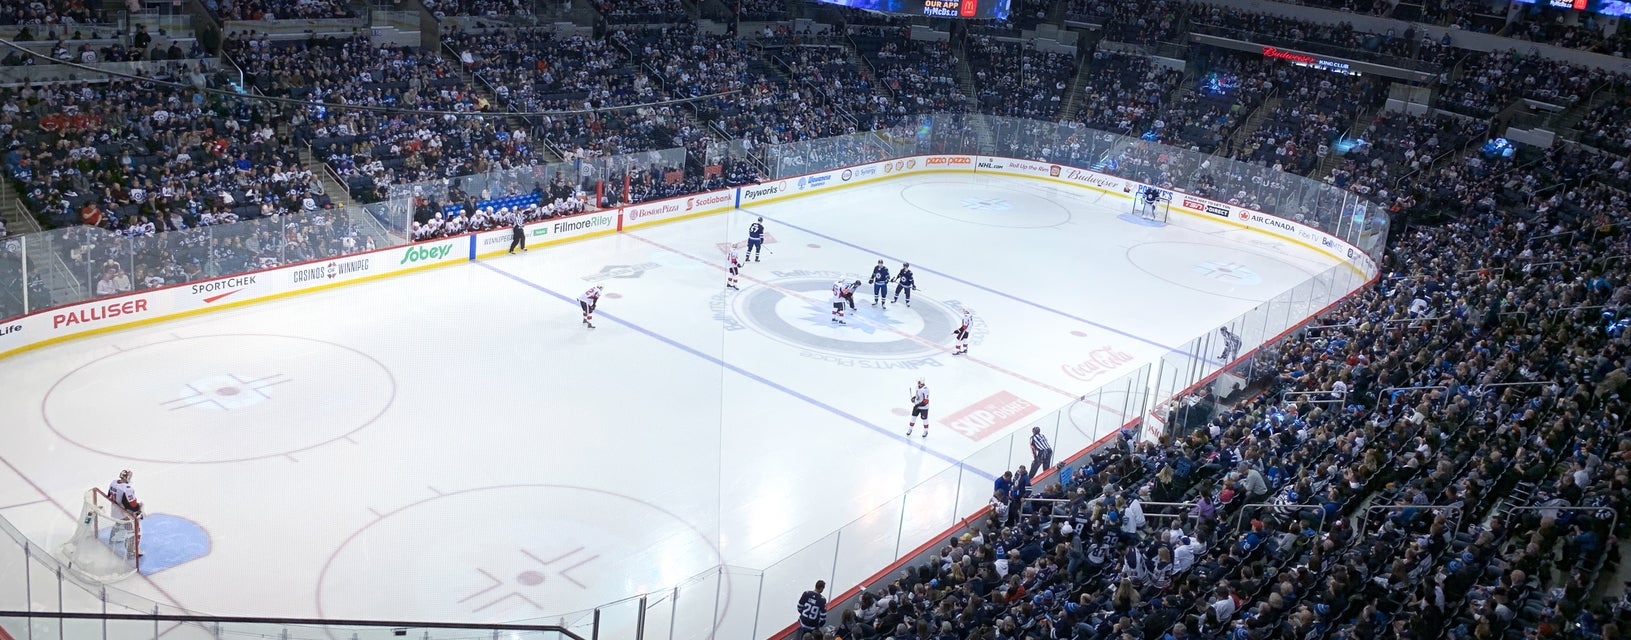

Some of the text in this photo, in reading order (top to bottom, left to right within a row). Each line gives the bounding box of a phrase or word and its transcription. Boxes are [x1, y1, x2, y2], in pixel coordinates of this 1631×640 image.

[1262, 46, 1316, 64] Budweiser
[926, 157, 971, 167] pizza pizza
[1066, 169, 1119, 189] Budweiser
[696, 194, 732, 206] Scotiabank
[744, 186, 778, 200] Payworks
[1185, 201, 1228, 216] TSN DIRECT
[1251, 215, 1295, 232] AIR CANADA
[400, 244, 453, 265] Sobeys
[293, 268, 325, 283] CASINOS
[338, 258, 369, 275] WINNIPEG
[53, 299, 148, 329] PALLISER
[950, 409, 996, 441] SKIP
[802, 602, 820, 620] 29
